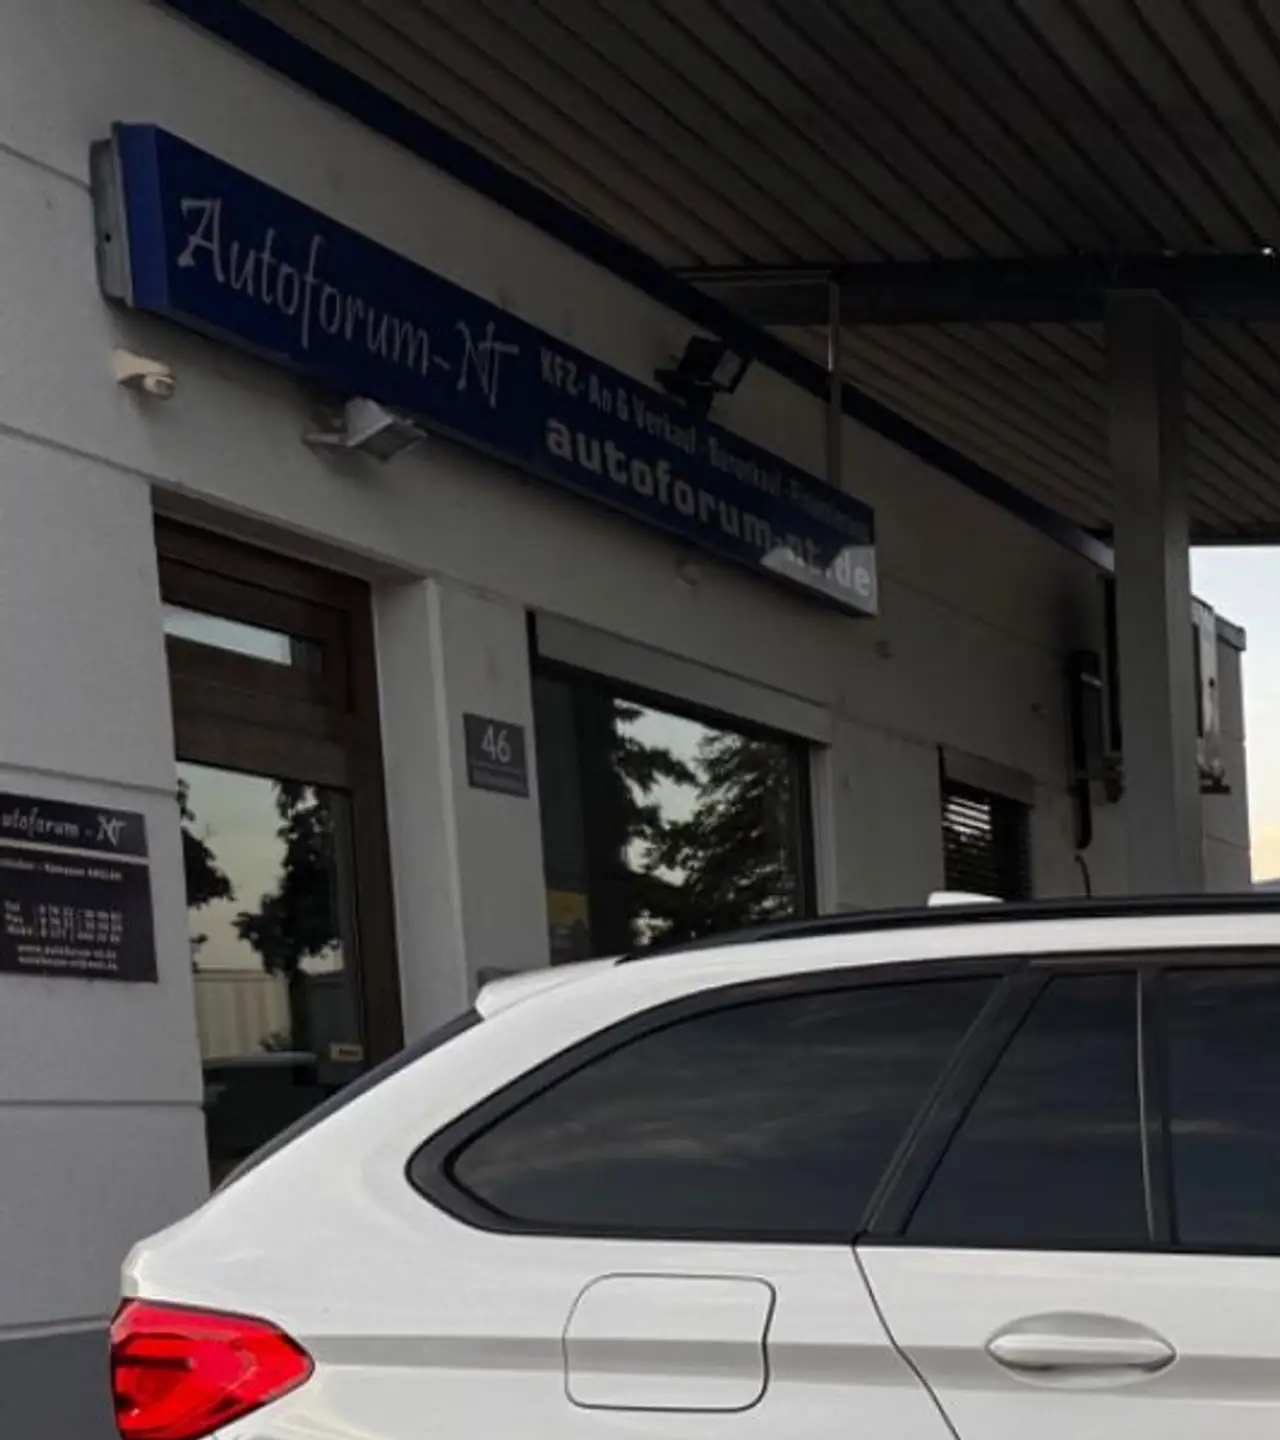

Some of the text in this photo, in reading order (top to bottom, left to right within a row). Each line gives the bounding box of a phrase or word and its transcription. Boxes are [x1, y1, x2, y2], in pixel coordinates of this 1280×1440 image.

[546, 418, 871, 597] autoforum-nt.de
[481, 723, 512, 764] 46
[0, 806, 80, 839] utoforum
